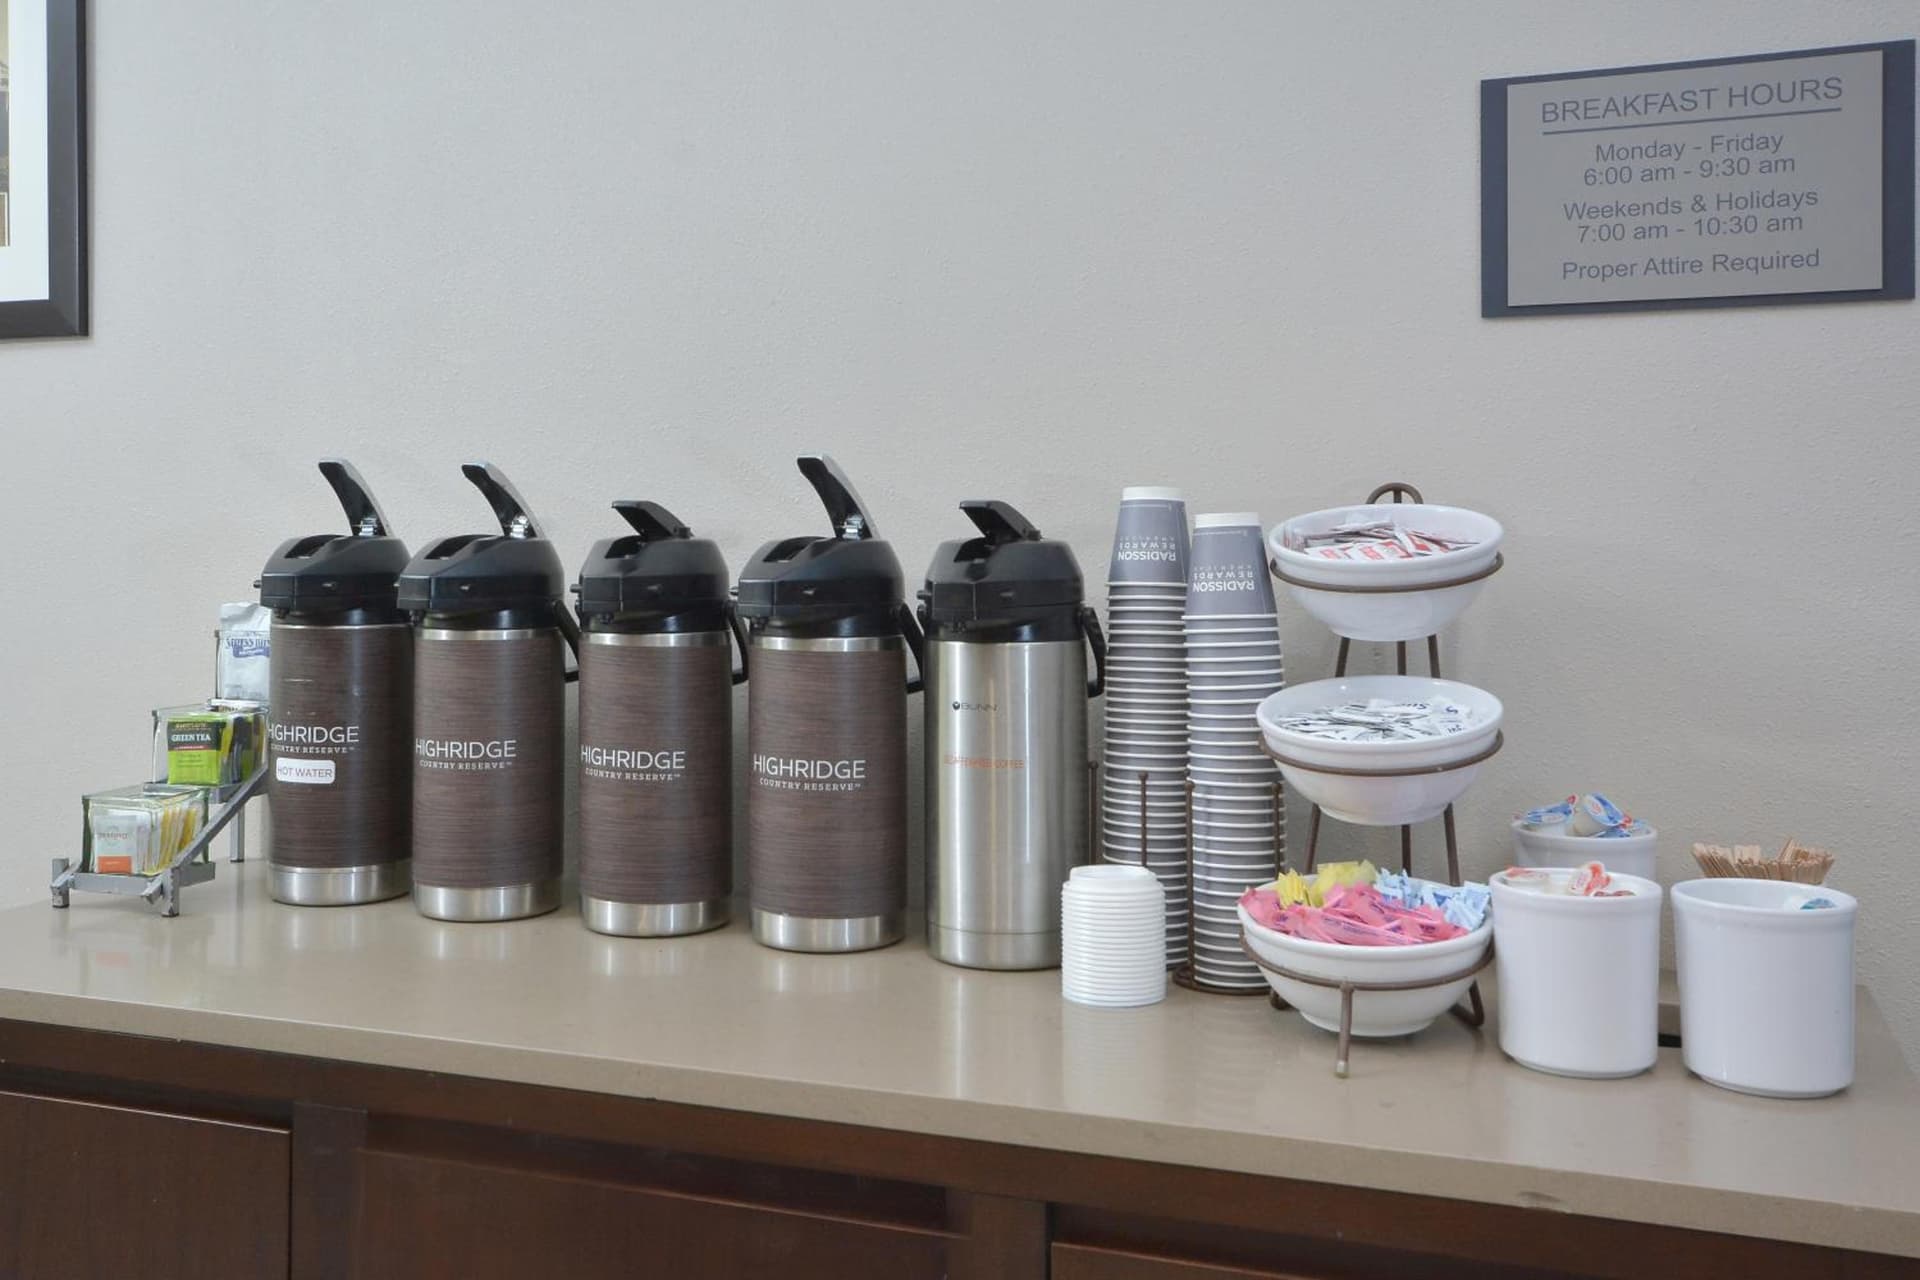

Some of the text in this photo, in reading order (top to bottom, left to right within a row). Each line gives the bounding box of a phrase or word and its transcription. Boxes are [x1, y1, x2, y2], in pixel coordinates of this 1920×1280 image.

[1541, 76, 1844, 124] BREAKFAST HOURS
[1595, 139, 1686, 163] Monday
[1710, 132, 1784, 154] Friday
[1584, 165, 1633, 186] 6:00
[1640, 165, 1676, 183] am
[1699, 156, 1751, 179] 9:30
[1759, 157, 1796, 174] am
[1563, 188, 1819, 221] Weekends & Holidays
[1578, 223, 1626, 243] 7:00
[1633, 224, 1669, 240] am
[1694, 214, 1759, 236] 10:30
[1766, 215, 1804, 233] am
[1563, 247, 1820, 283] Proper Attire Required
[1118, 551, 1176, 562] RADISSON
[1192, 579, 1256, 593] RADISSON
[171, 733, 211, 742] GREEN TEA
[415, 738, 517, 759] HIGHRIDGE
[458, 762, 505, 770] RESERVE
[580, 744, 686, 769] HIGHRIDGE
[753, 753, 867, 779] HIGHRIDGE
[296, 767, 333, 778] WATER
[585, 767, 673, 781] COUNTRY RESERVE
[759, 777, 855, 791] COUNTRY RESERVE
